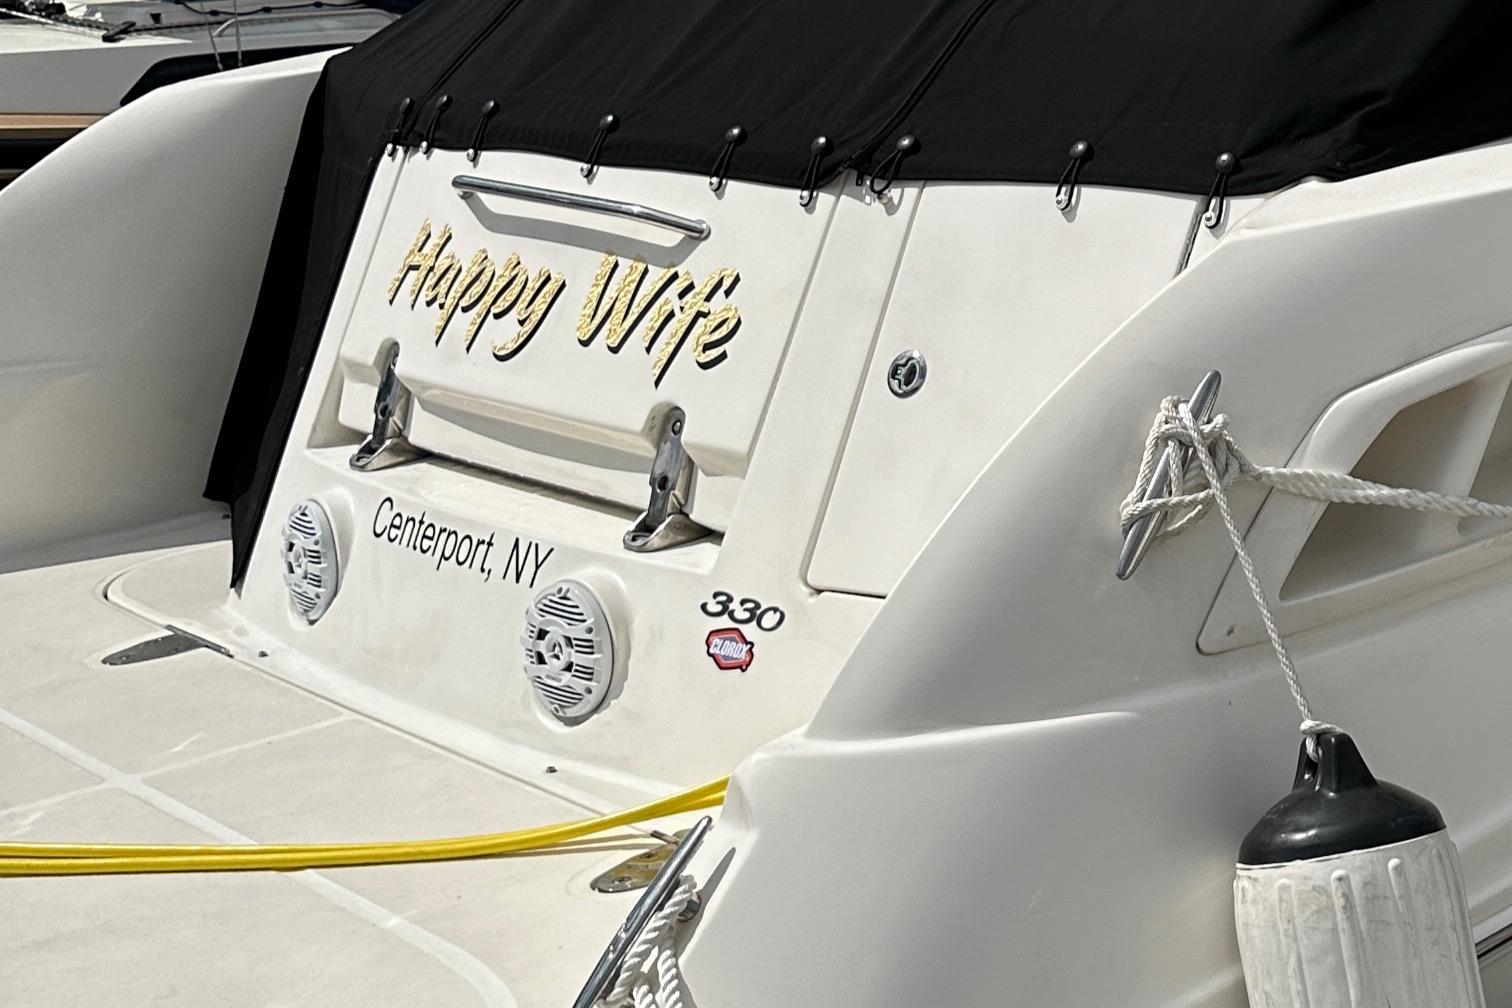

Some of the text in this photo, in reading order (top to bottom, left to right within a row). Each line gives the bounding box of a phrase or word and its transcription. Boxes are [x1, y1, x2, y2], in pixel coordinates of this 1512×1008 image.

[388, 218, 741, 389] Happy Wife
[373, 497, 554, 589] Centerport, NY
[700, 590, 786, 632] 330
[708, 637, 752, 660] CLOROX
